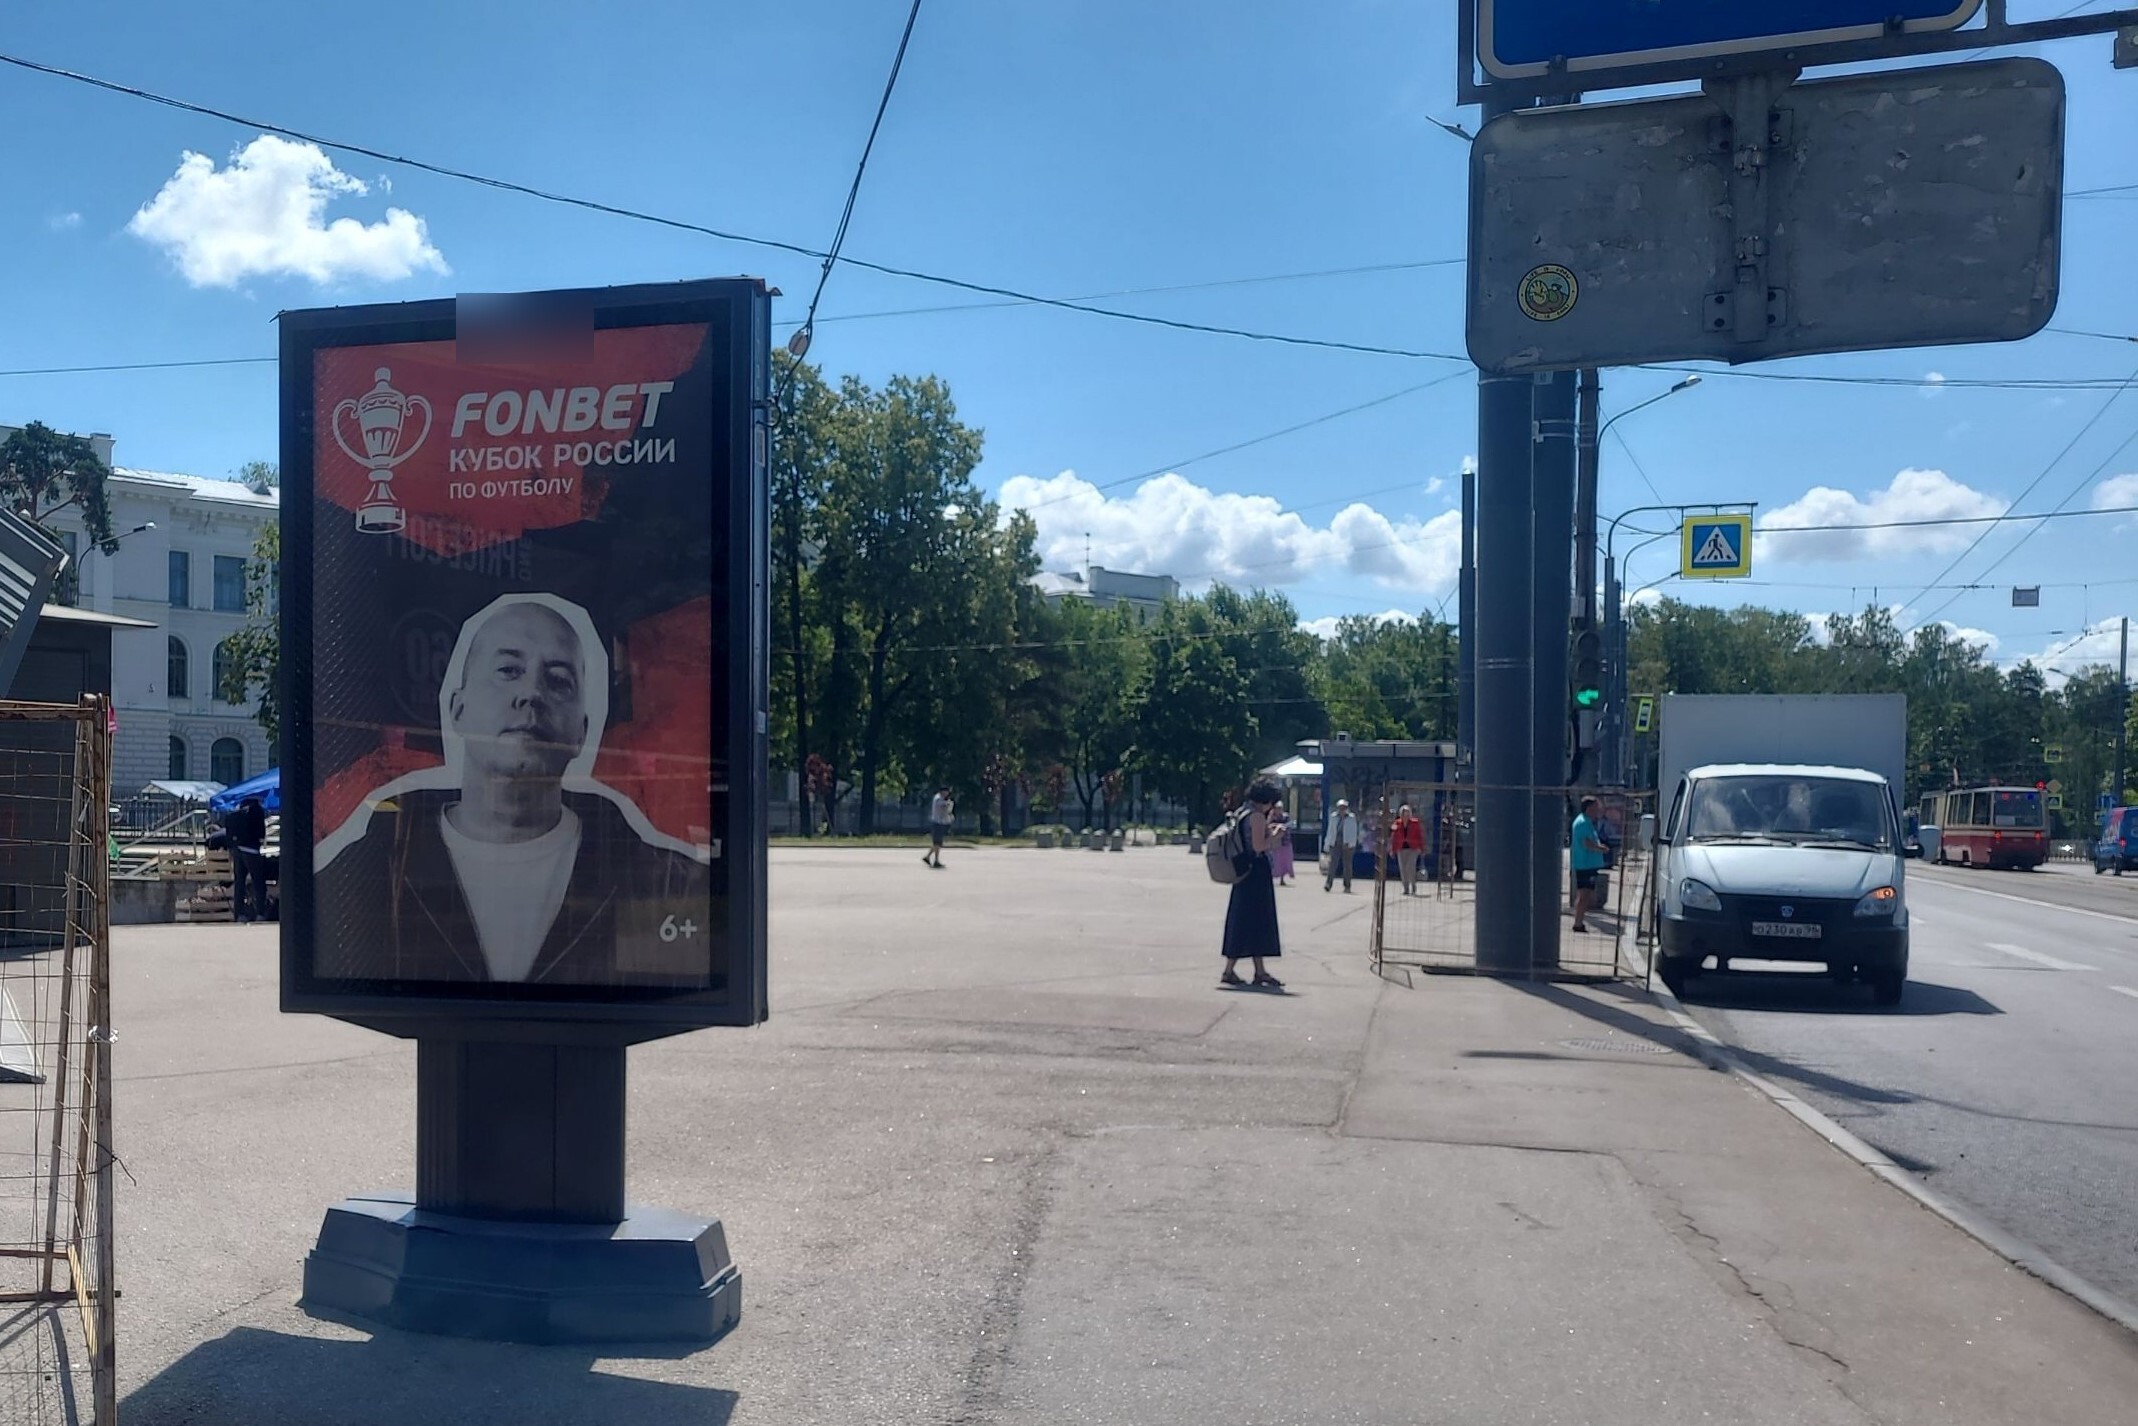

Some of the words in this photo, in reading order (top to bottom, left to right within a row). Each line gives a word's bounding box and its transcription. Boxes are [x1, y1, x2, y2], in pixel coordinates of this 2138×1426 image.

[451, 381, 674, 438] FONBET
[450, 445, 543, 473] КУБОК
[553, 438, 675, 467] РОССИИ
[450, 482, 476, 499] ПО
[481, 478, 574, 498] ФУТБОЛУ
[660, 914, 698, 942] 6+
